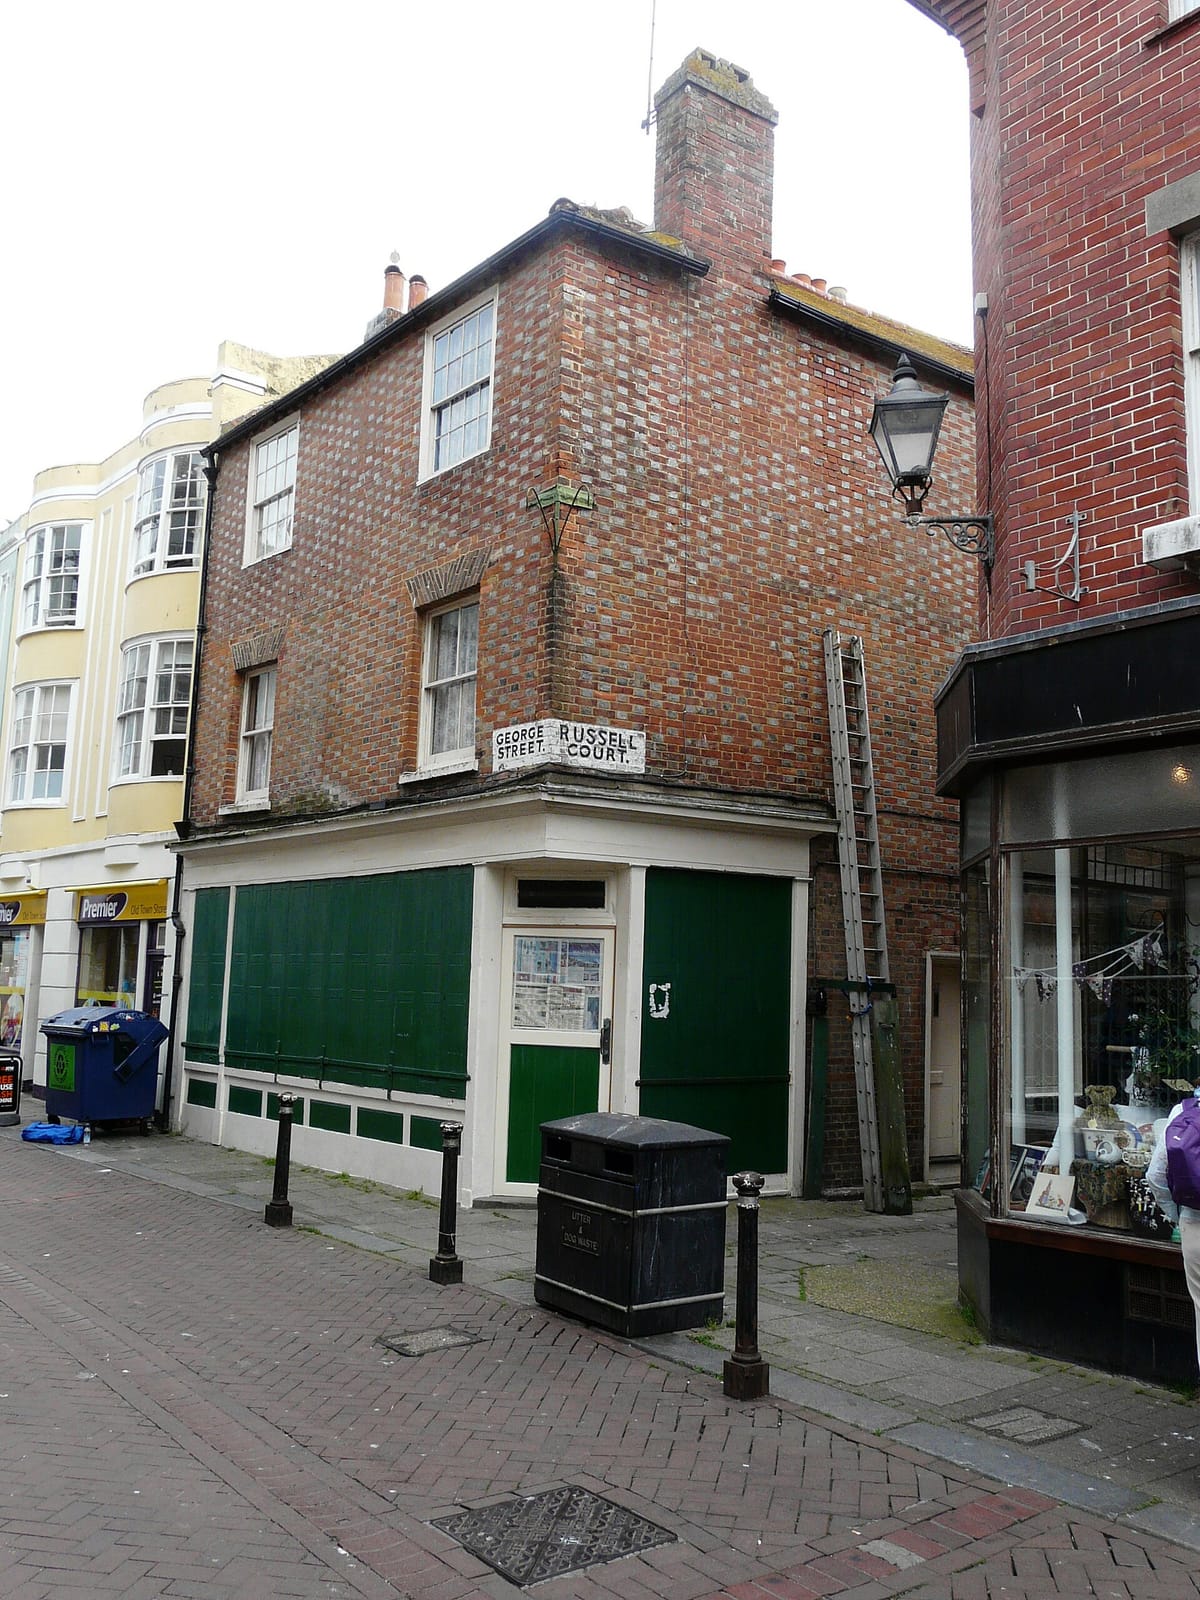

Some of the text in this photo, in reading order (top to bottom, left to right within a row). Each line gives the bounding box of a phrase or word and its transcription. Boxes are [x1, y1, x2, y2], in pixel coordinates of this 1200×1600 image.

[496, 725, 544, 746] GEORGE
[559, 724, 637, 750] RUSSELL
[497, 739, 546, 760] STREET.
[567, 743, 630, 764] COURT.
[82, 899, 118, 918] Premier
[571, 1210, 591, 1225] LITTER
[564, 1232, 598, 1250] DOG WASTE
